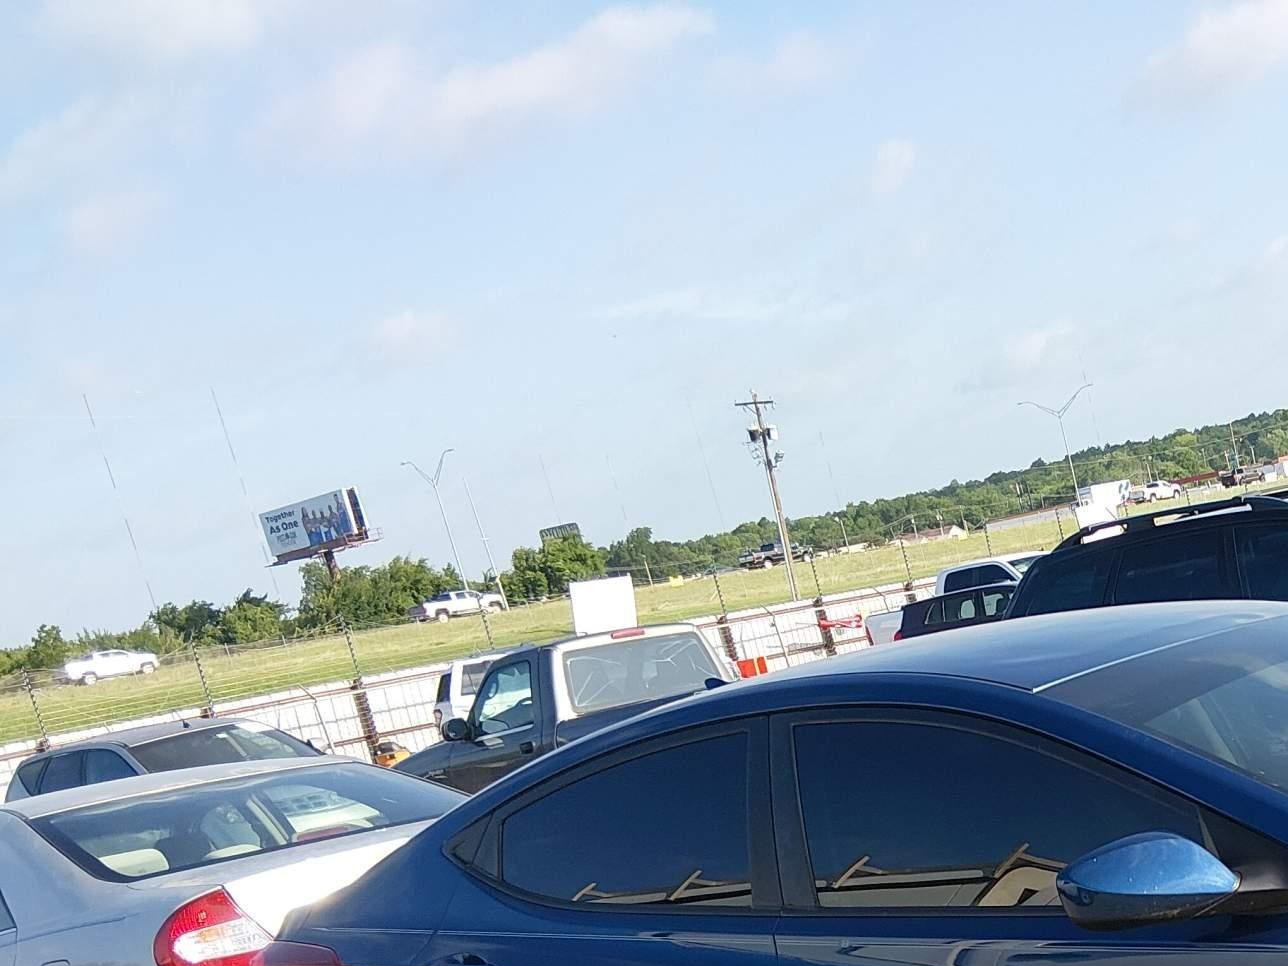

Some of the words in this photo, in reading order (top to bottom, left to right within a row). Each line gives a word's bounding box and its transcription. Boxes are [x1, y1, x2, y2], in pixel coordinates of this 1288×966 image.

[265, 510, 295, 523] Together
[269, 525, 281, 535] As
[281, 520, 299, 530] One
